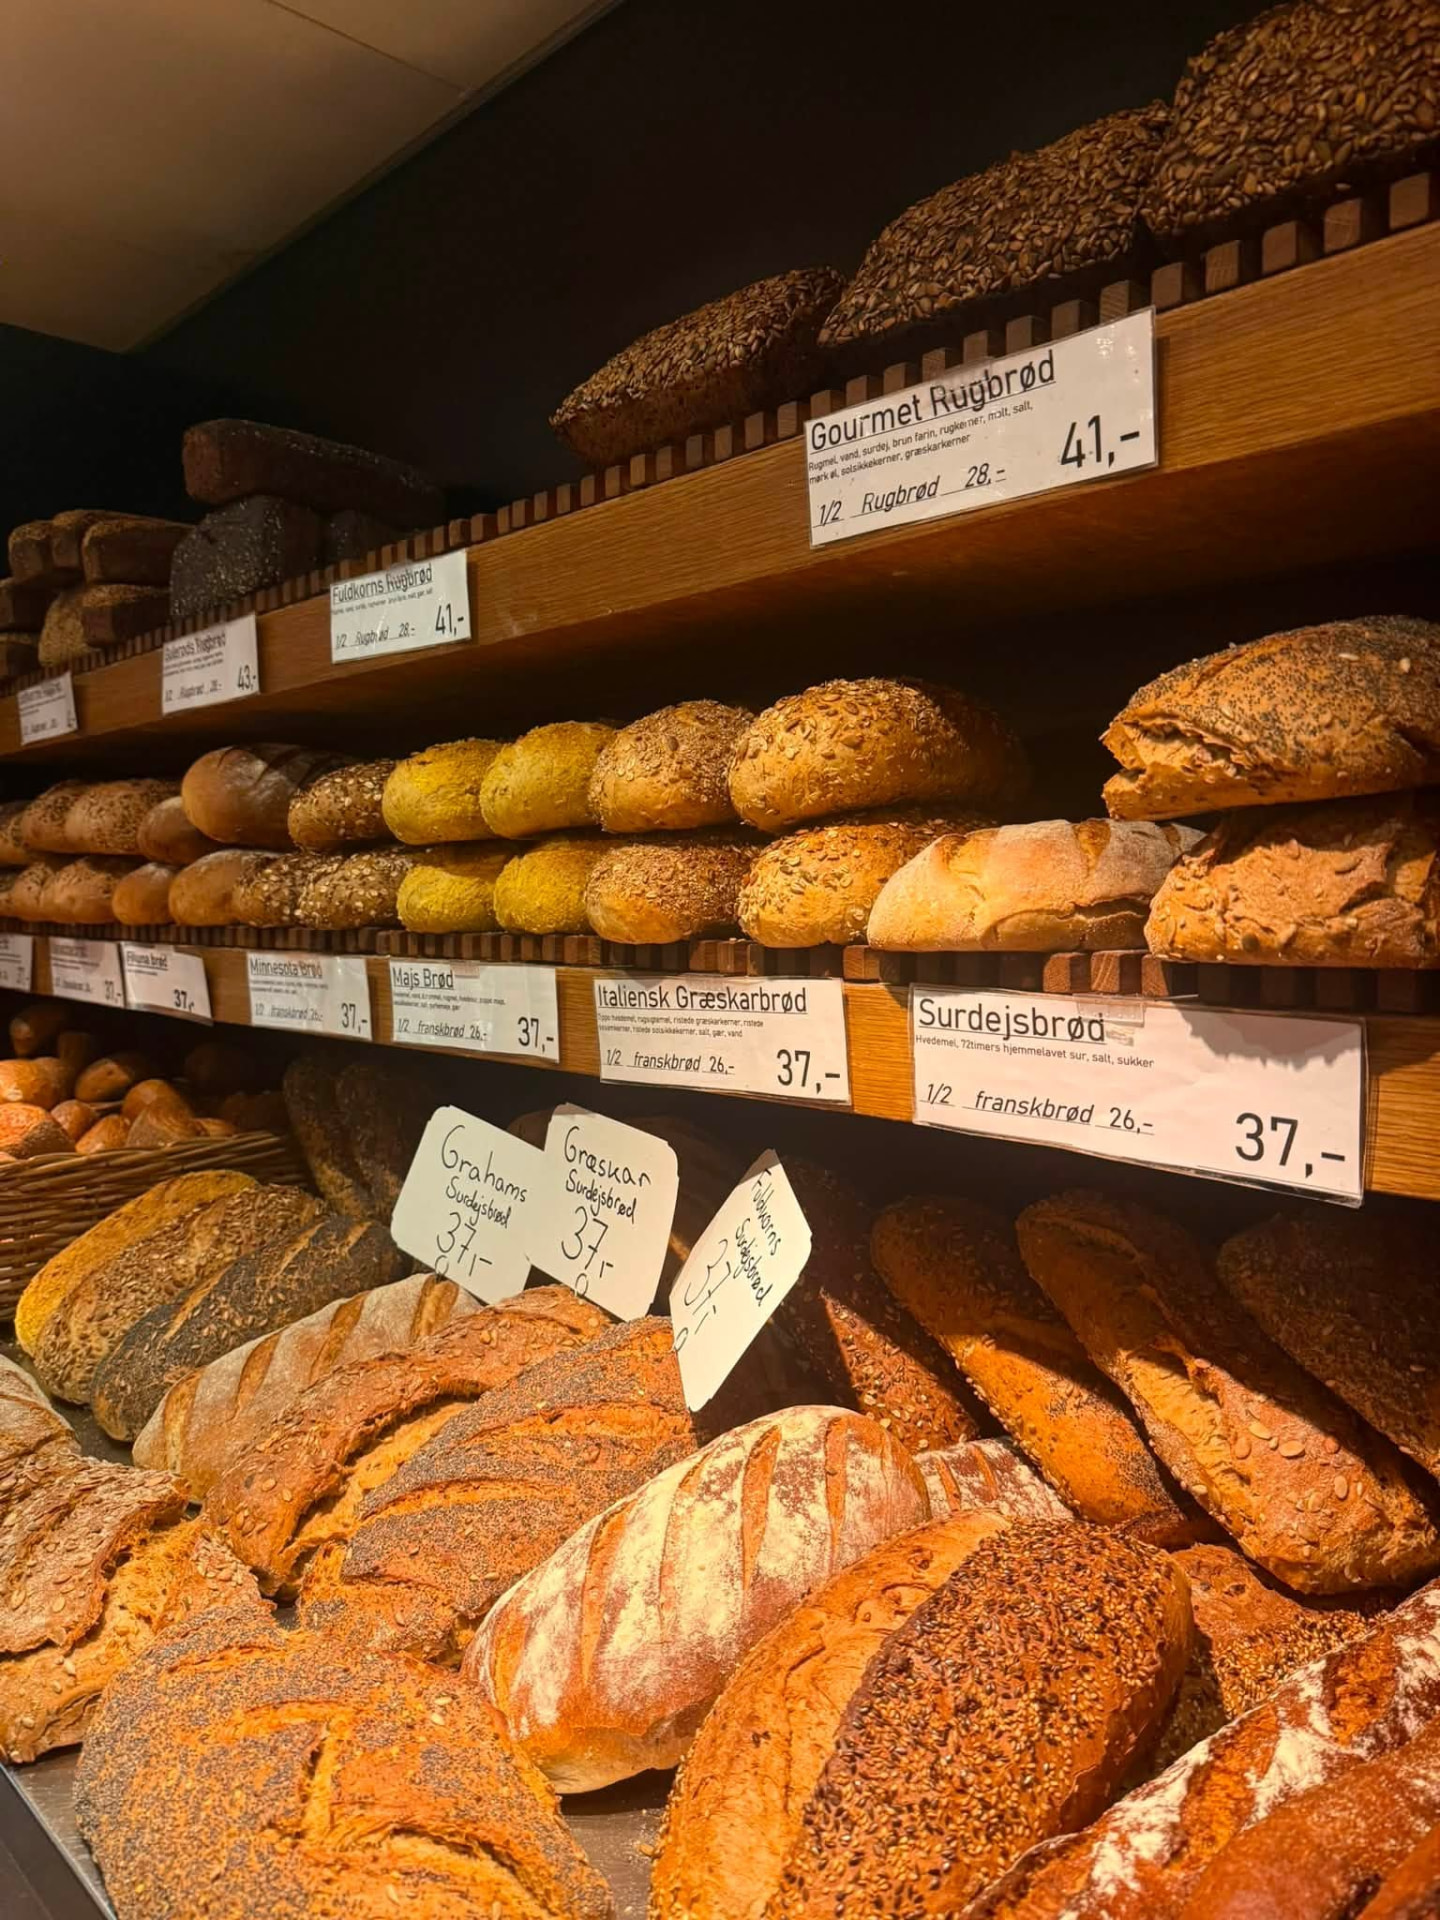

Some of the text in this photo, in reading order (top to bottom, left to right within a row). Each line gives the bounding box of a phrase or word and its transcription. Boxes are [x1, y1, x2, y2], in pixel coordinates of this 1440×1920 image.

[811, 349, 1055, 451] Gourmet Rugbrød
[840, 449, 860, 463] vand,
[862, 441, 890, 457] surdej,
[892, 433, 914, 448] brun
[914, 428, 939, 443] farin,
[1012, 401, 1034, 415] salt,
[1060, 415, 1141, 470] 41,-
[840, 453, 903, 477] solsikkekerner,
[904, 434, 972, 461] græskarkerner
[819, 462, 1006, 526] 1/2 Rugbrød 28,-
[332, 579, 385, 603] Fuldkorns
[385, 563, 433, 593] Rugbrød
[435, 603, 464, 637] 41,-
[250, 958, 299, 977] Minnesota
[393, 967, 455, 990] Majs Brød
[341, 1002, 368, 1033] 37,-
[598, 984, 807, 1012] Italiensk Græskarbrød
[418, 1020, 466, 1038] franskbrød
[517, 1016, 554, 1053] 37,-
[918, 998, 1106, 1042] Surdejsbrød
[606, 1049, 735, 1075] 1/2 franskbrød 26,-
[776, 1048, 841, 1094] 37,-
[915, 1034, 1155, 1069] Hvedemel, 72timers hjemmelavet sur, salt, sukker
[925, 1082, 1155, 1134] 1/2 franskbrød 26,-
[441, 1124, 528, 1203] Grahams
[1235, 1112, 1346, 1179] 37,-
[565, 1168, 638, 1225] Surdejsbrød
